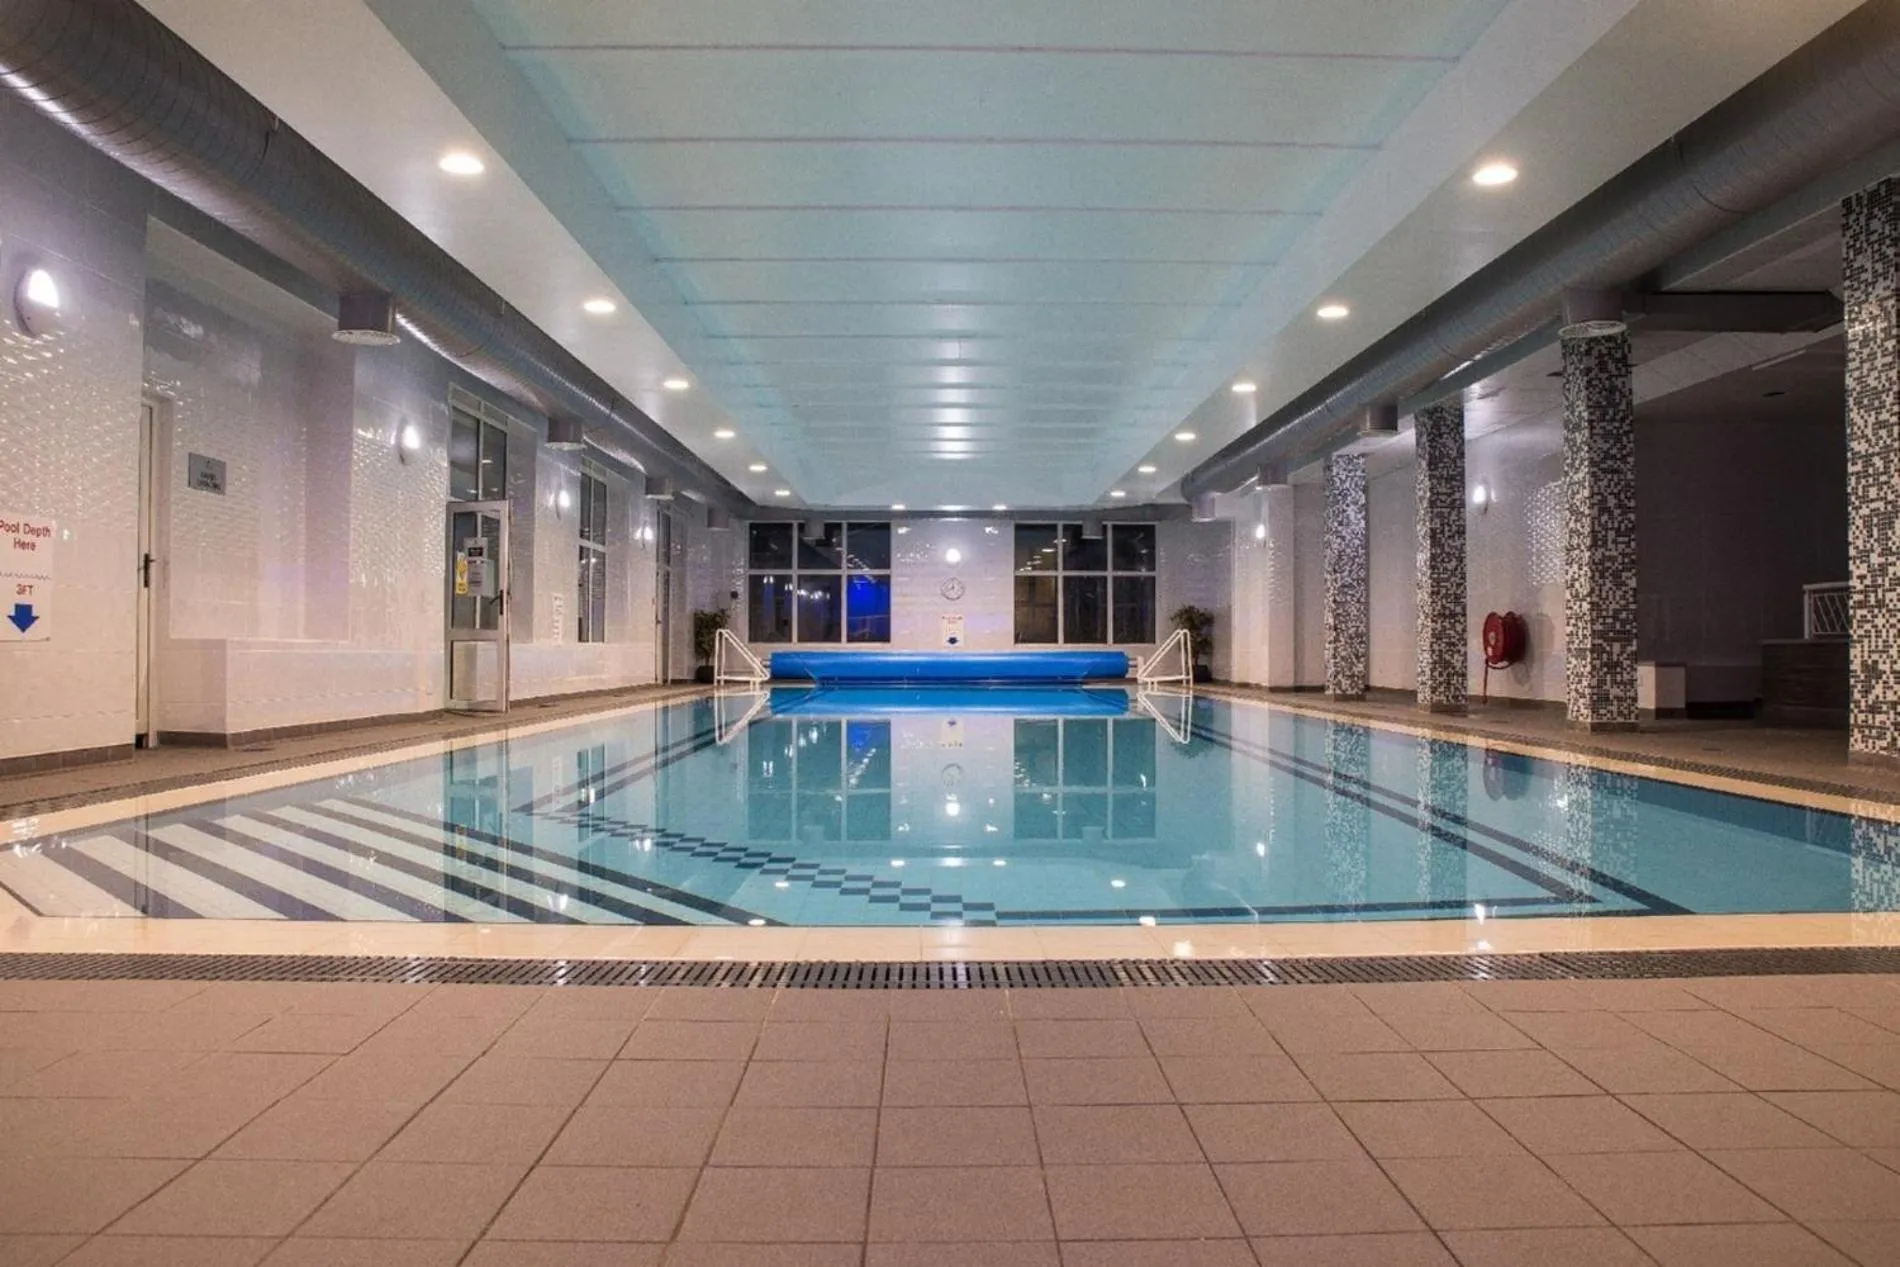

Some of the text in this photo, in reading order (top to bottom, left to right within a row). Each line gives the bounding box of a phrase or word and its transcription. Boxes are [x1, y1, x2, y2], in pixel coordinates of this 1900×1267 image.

[0, 520, 51, 538] Pool Depth
[13, 537, 36, 551] Here
